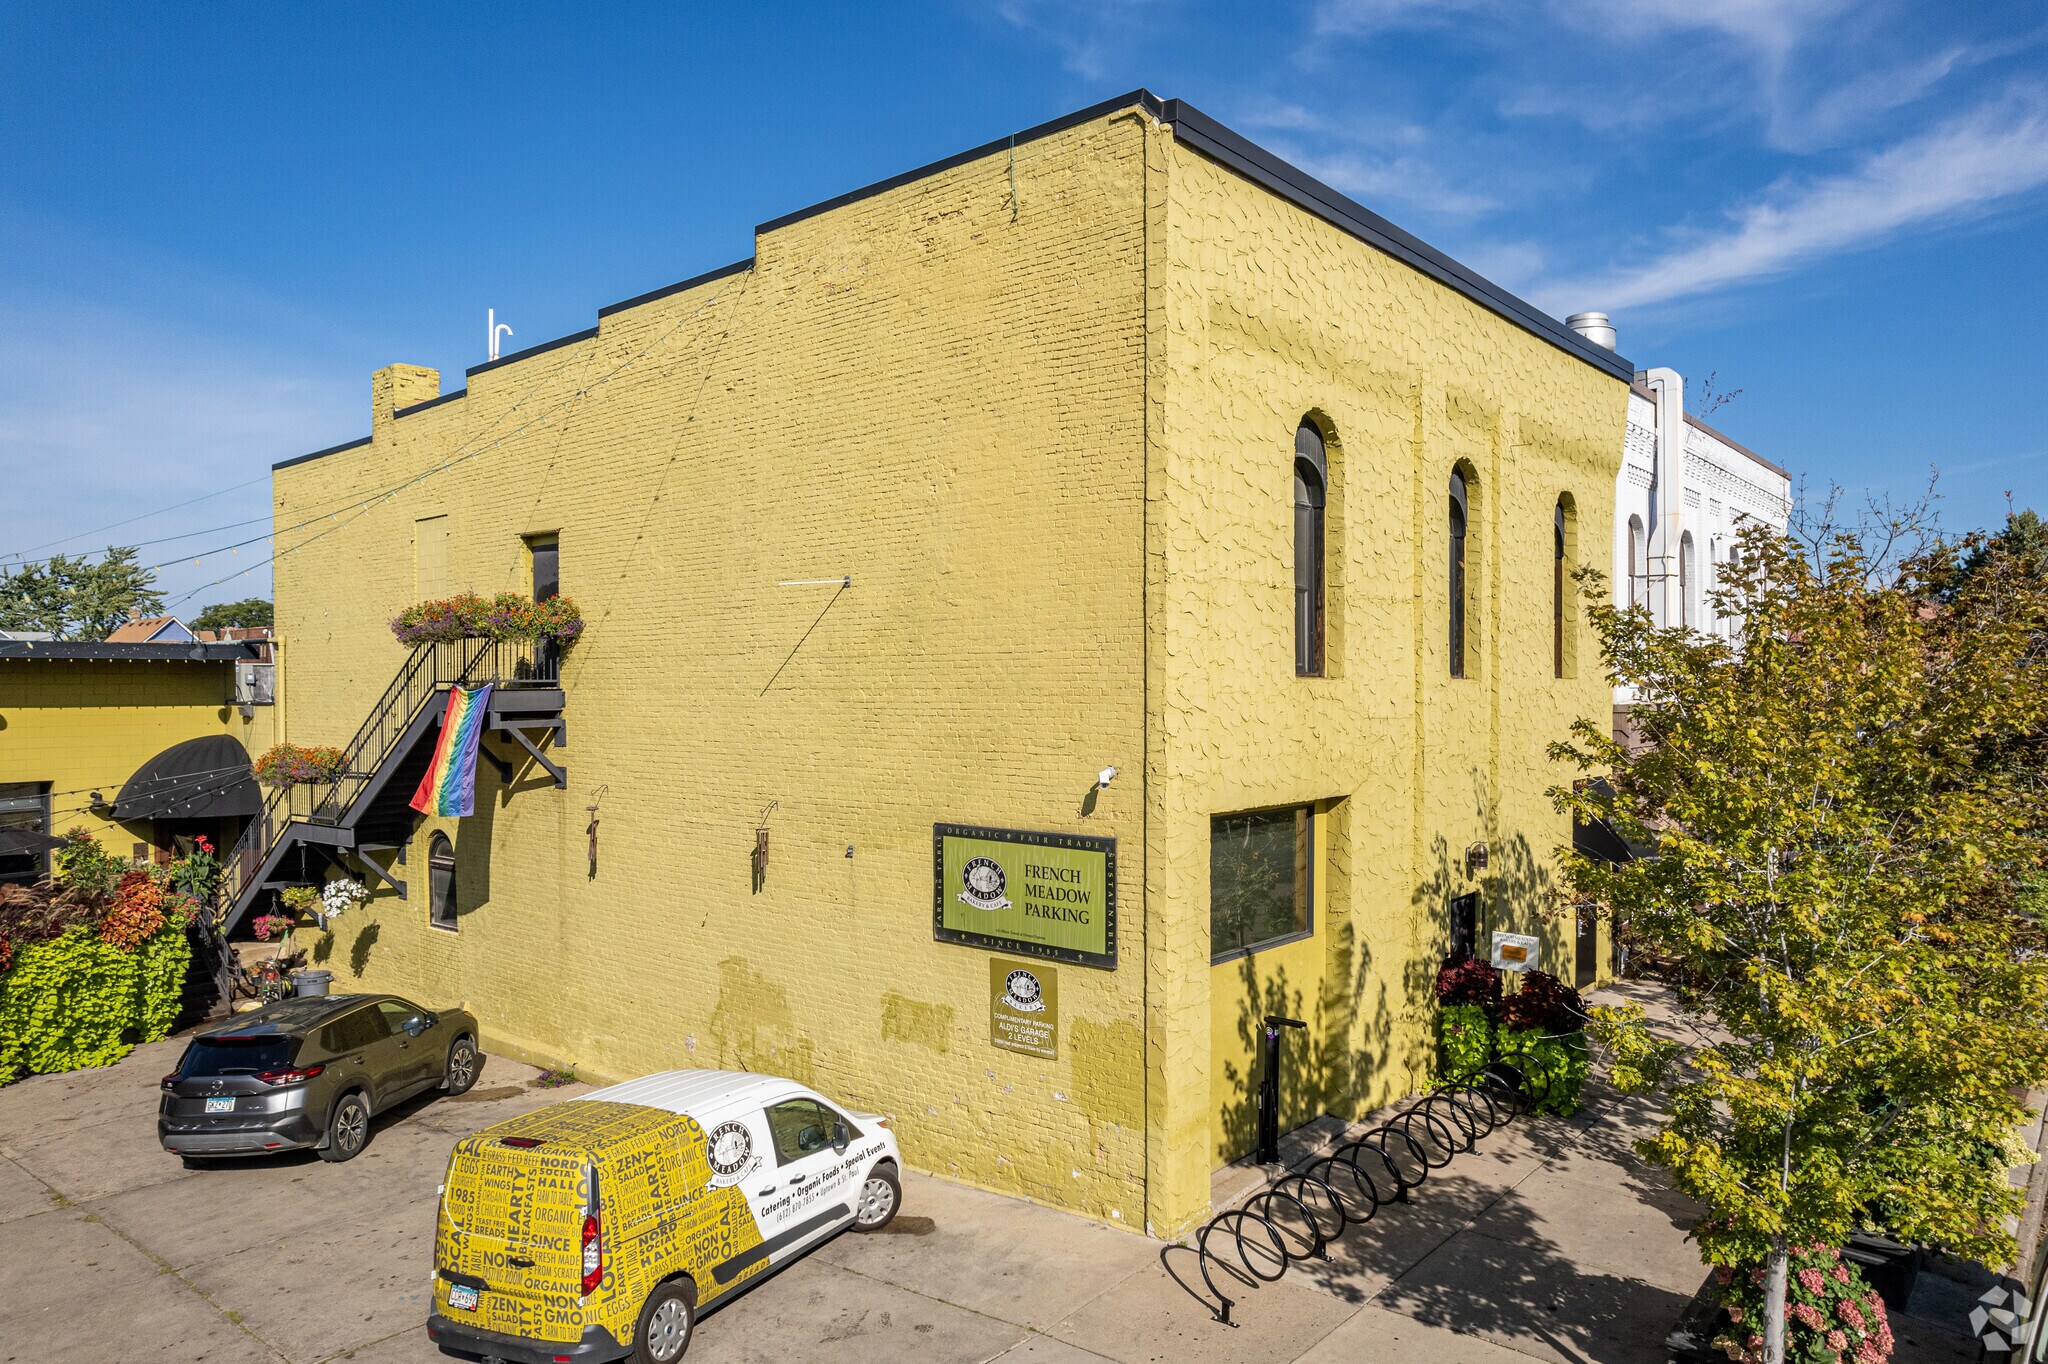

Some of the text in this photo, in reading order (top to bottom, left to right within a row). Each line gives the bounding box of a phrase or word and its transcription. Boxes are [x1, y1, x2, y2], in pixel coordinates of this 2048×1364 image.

[947, 827, 1100, 849] ORGANIC FAIR TRADE
[1025, 864, 1081, 884] FRENCH
[1025, 883, 1091, 905] MEADOW
[1107, 852, 1115, 956] SUSTAINABLE
[1025, 902, 1090, 925] PARKING
[983, 937, 1059, 956] SINCE 1985
[1008, 1032, 1039, 1045] 2 LEVELS
[1020, 1026, 1049, 1039] GARAGE
[657, 1121, 688, 1143] NORD
[709, 1124, 745, 1147] FRENCH
[487, 1150, 540, 1167] GRASS FED BEEF
[540, 1157, 580, 1170] NORD
[616, 1151, 642, 1174] ZEN
[713, 1146, 750, 1173] MEADOW
[485, 1163, 514, 1178] EARTH
[539, 1167, 576, 1179] SOCIAL
[617, 1165, 645, 1185] SALAD
[761, 1195, 791, 1218] Catering
[796, 1175, 821, 1197] Organic
[822, 1165, 840, 1183] Foods
[845, 1149, 866, 1170] Special
[867, 1141, 886, 1157] Events
[484, 1177, 511, 1191] WINGS
[537, 1177, 574, 1190] HALL
[642, 1150, 667, 1228] HEARTY
[450, 1187, 475, 1204] 1985
[673, 1186, 705, 1211] SINCE
[504, 1167, 526, 1253] HEARTY
[518, 1168, 537, 1254] BREAKFASTS
[534, 1206, 575, 1225] ORGANIC
[776, 1208, 791, 1223] (612)
[622, 1211, 653, 1232] BREADS
[474, 1225, 506, 1239] BREADS
[638, 1222, 678, 1248] NORD
[685, 1220, 719, 1244] ORGANIC
[530, 1233, 571, 1252] SINCE
[639, 1232, 678, 1257] SOCIAL
[693, 1231, 719, 1256] NON
[535, 1250, 581, 1267] FRESH MADE
[640, 1242, 680, 1269] HALL
[695, 1246, 720, 1270] GMO
[534, 1264, 552, 1278] FROM
[615, 1255, 627, 1297] EARTH
[524, 1277, 582, 1295] ORGANIC
[491, 1296, 518, 1314] ZEN
[543, 1293, 582, 1310] NON
[606, 1296, 631, 1318] EGGS
[544, 1308, 584, 1326] GMO
